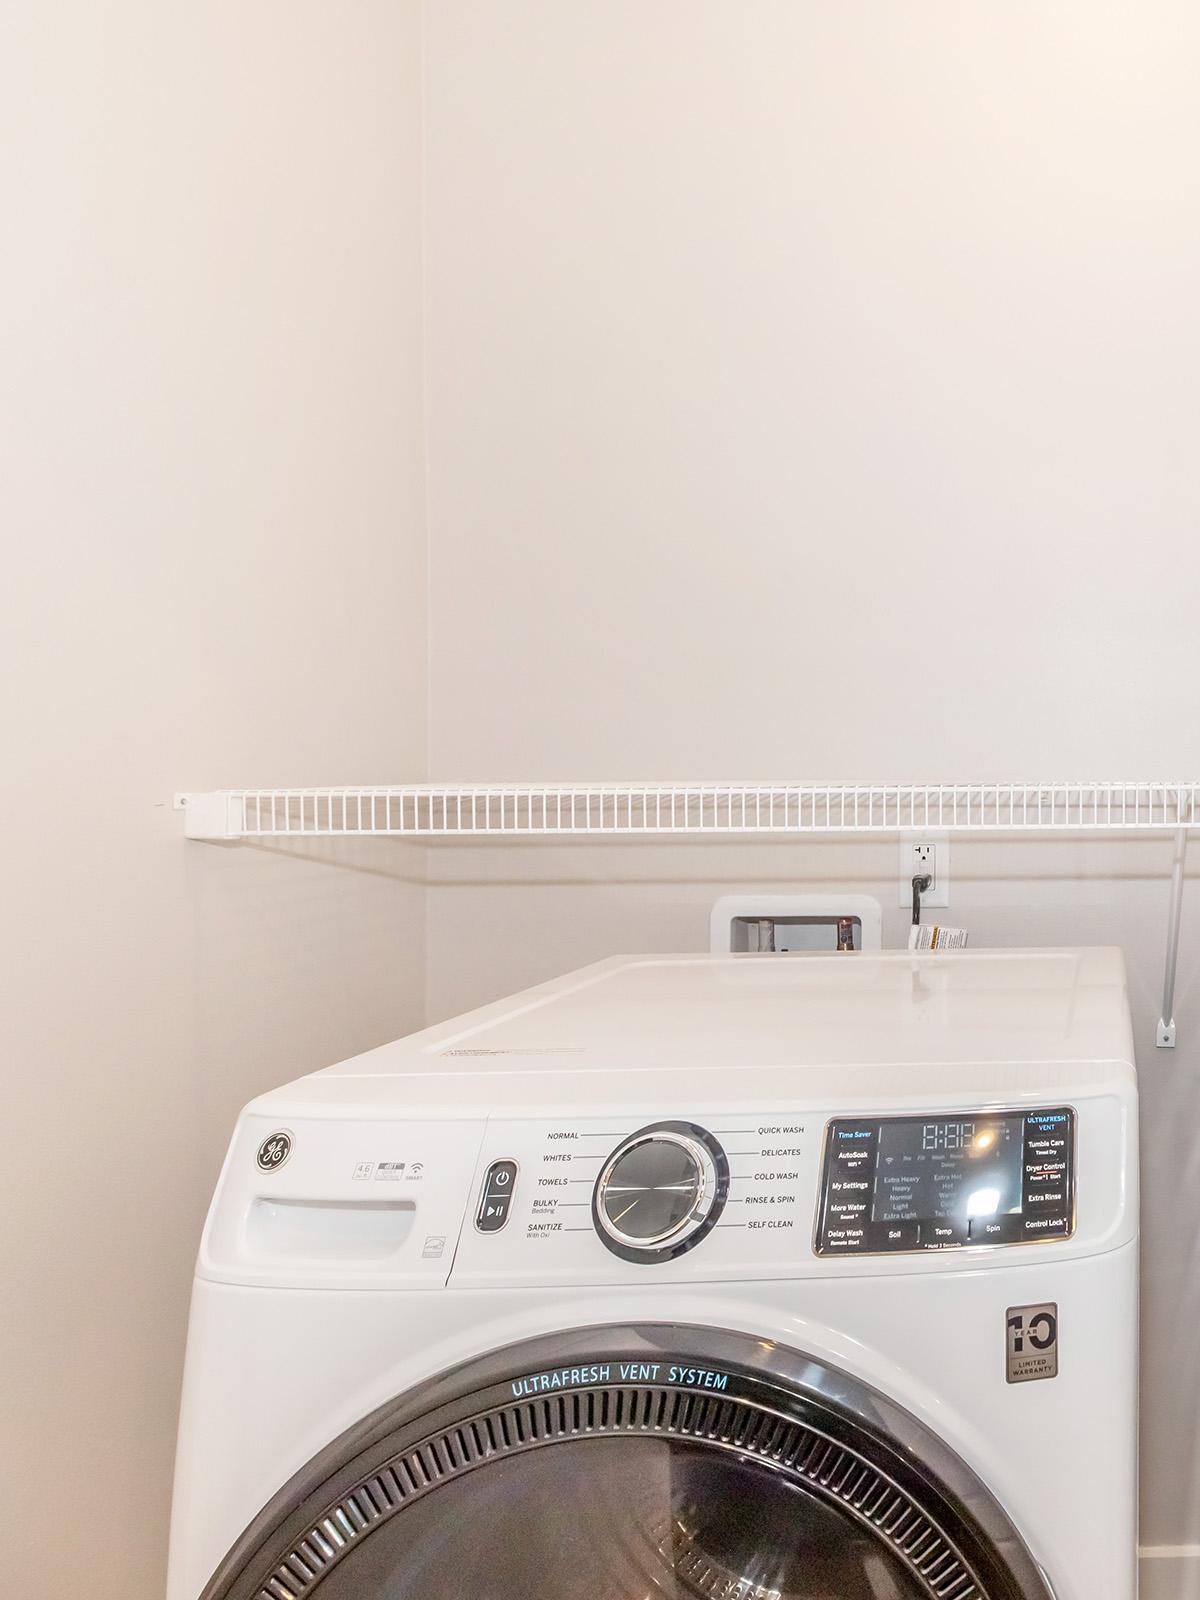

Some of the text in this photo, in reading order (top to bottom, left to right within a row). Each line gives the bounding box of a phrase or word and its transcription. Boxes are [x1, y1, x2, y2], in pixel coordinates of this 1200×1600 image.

[783, 1126, 804, 1134] WASH
[1028, 1140, 1049, 1148] Tumble
[1026, 1162, 1065, 1173] Dryer Control
[777, 1172, 798, 1180] WASH
[538, 1178, 568, 1186] TOWELS
[745, 1196, 767, 1204] RINSE
[527, 1223, 562, 1231] SANITIZE
[1049, 1219, 1063, 1227] Lock
[935, 1228, 952, 1236] Temp
[986, 1224, 1000, 1232] Spin
[1008, 1312, 1056, 1352] 10
[1019, 1359, 1046, 1367] LIMITED
[1013, 1366, 1052, 1376] WARRANTY
[512, 1365, 728, 1396] ULTRAFRESH VENT SYSTEM
